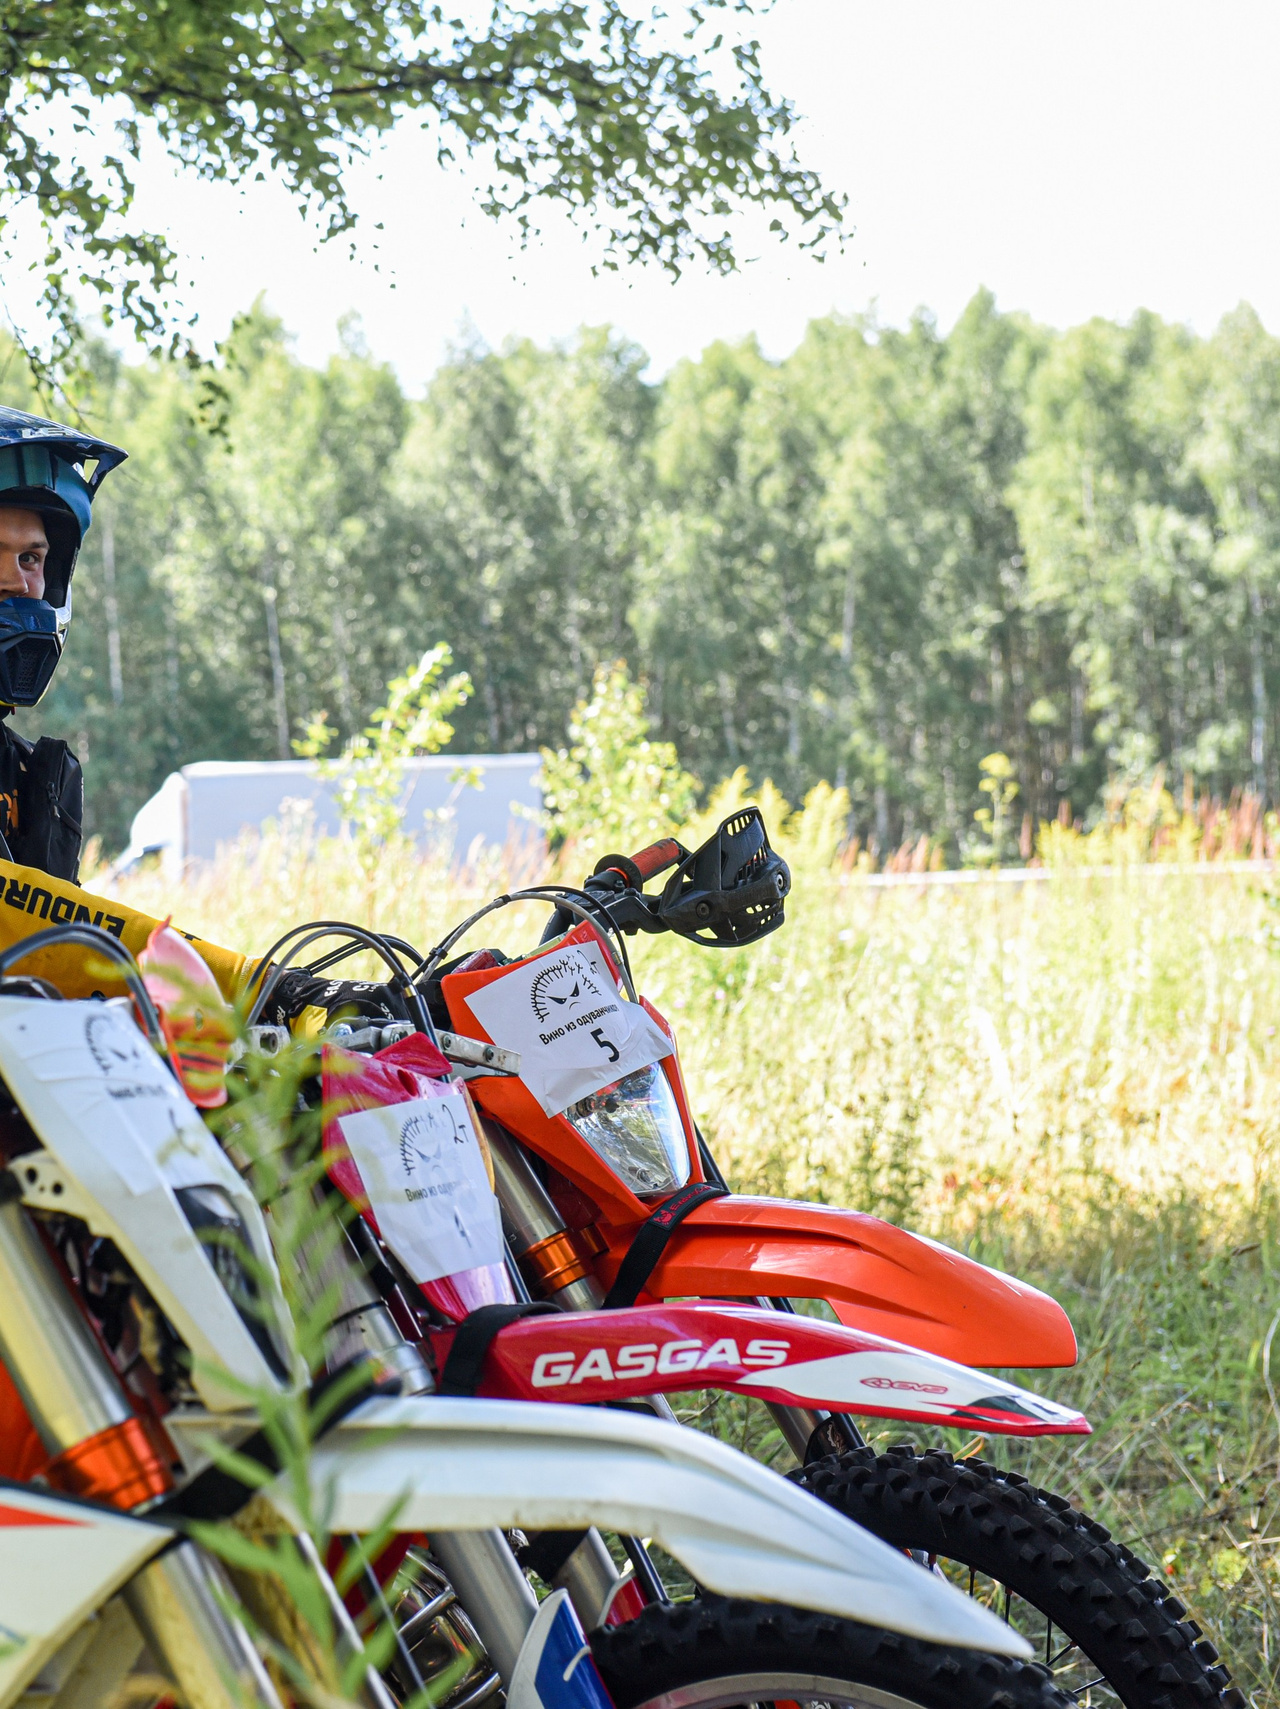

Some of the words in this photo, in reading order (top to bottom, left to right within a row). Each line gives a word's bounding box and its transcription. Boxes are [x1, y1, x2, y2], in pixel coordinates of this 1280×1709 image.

[538, 1023, 566, 1046] Вино
[565, 1019, 578, 1034] из
[589, 1027, 621, 1064] 5
[530, 1338, 792, 1388] GASGAS
